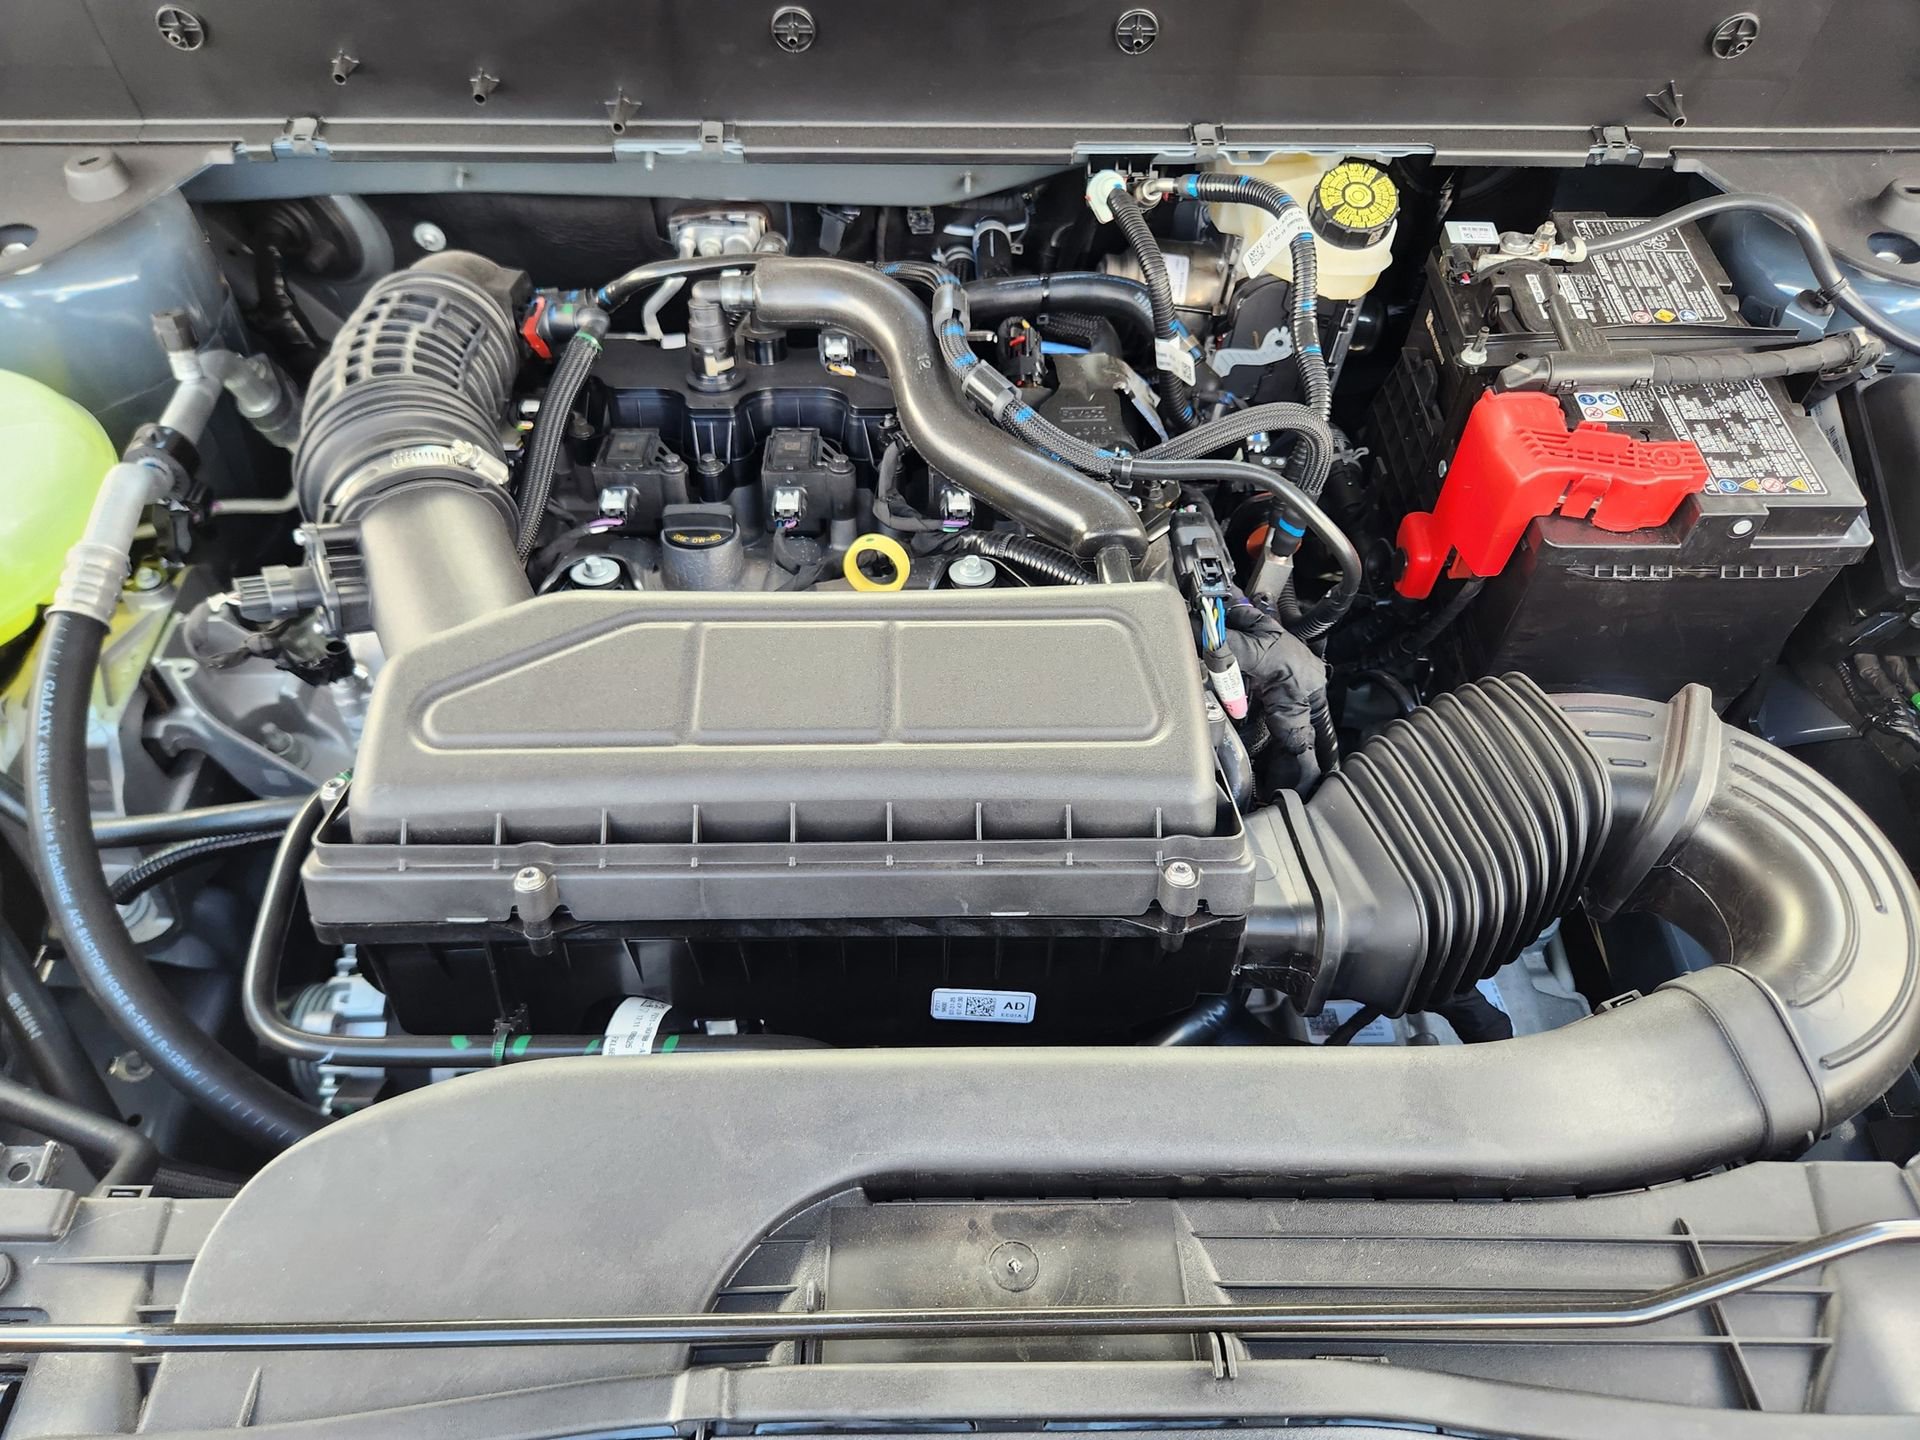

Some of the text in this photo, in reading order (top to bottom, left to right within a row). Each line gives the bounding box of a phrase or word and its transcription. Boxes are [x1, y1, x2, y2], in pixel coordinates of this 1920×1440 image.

[38, 680, 56, 737] GALAXY
[76, 927, 110, 976] SUCTION
[104, 975, 130, 1004] HOSE
[124, 1003, 155, 1038] R-134a
[1003, 1001, 1025, 1011] AD
